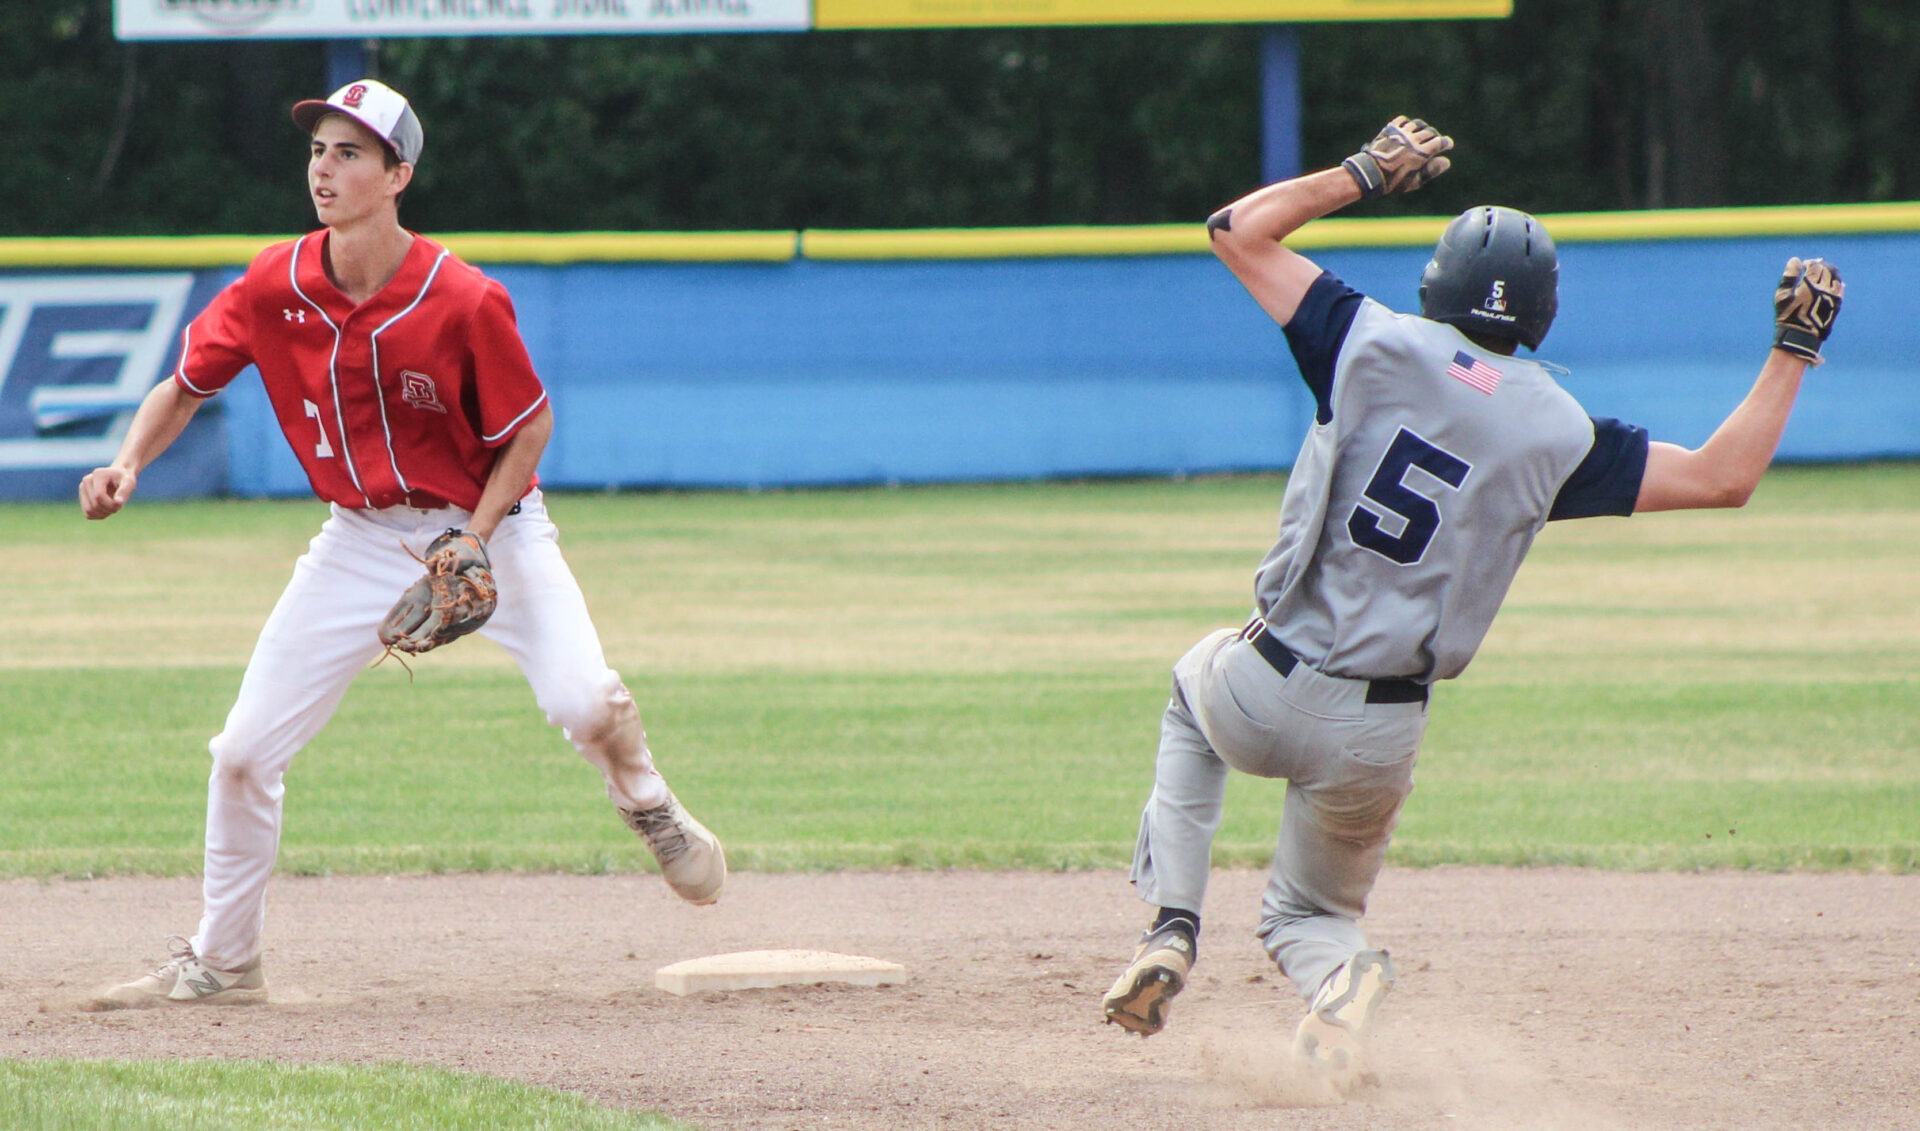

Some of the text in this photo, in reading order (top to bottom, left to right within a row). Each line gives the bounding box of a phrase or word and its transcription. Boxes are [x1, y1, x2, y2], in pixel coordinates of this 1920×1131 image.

[1492, 280, 1506, 299] 5
[303, 398, 335, 458] 7
[1346, 424, 1474, 566] 5
